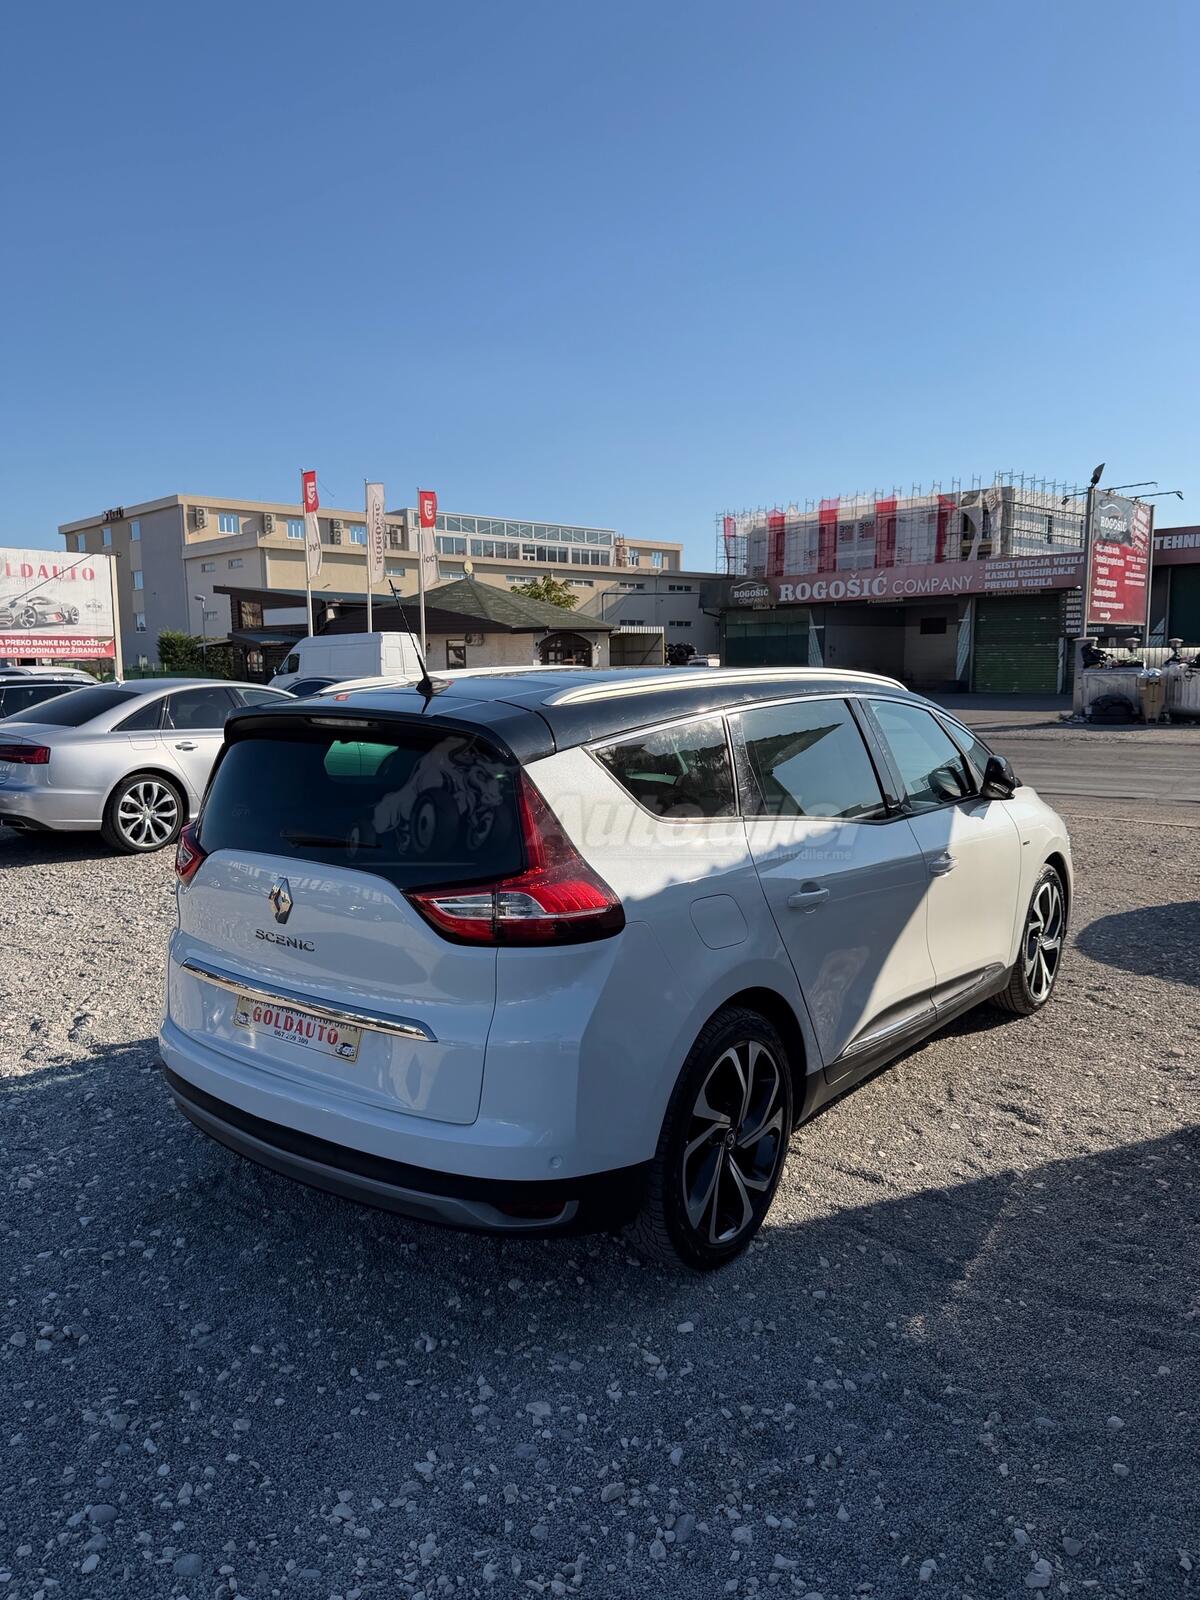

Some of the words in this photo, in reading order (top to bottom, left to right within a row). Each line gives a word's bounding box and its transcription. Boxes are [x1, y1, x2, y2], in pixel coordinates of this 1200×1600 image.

[985, 557, 1051, 571] REGISTRACIJA
[1054, 555, 1084, 566] VOZILA
[0, 562, 95, 581] LDAUTO
[984, 569, 1016, 581] KASKO
[1018, 566, 1077, 578] OSIGURANJE
[778, 571, 888, 602] ROGOŠIĆ
[892, 575, 974, 595] COMPANY
[984, 579, 1019, 590] PREVOD
[1022, 577, 1053, 588] VOZILA
[734, 586, 769, 599] ROGOŠIĆ
[71, 646, 106, 655] ŽIRANATA
[255, 928, 316, 952] SCENIC
[252, 1006, 339, 1045] GOLDAUTO
